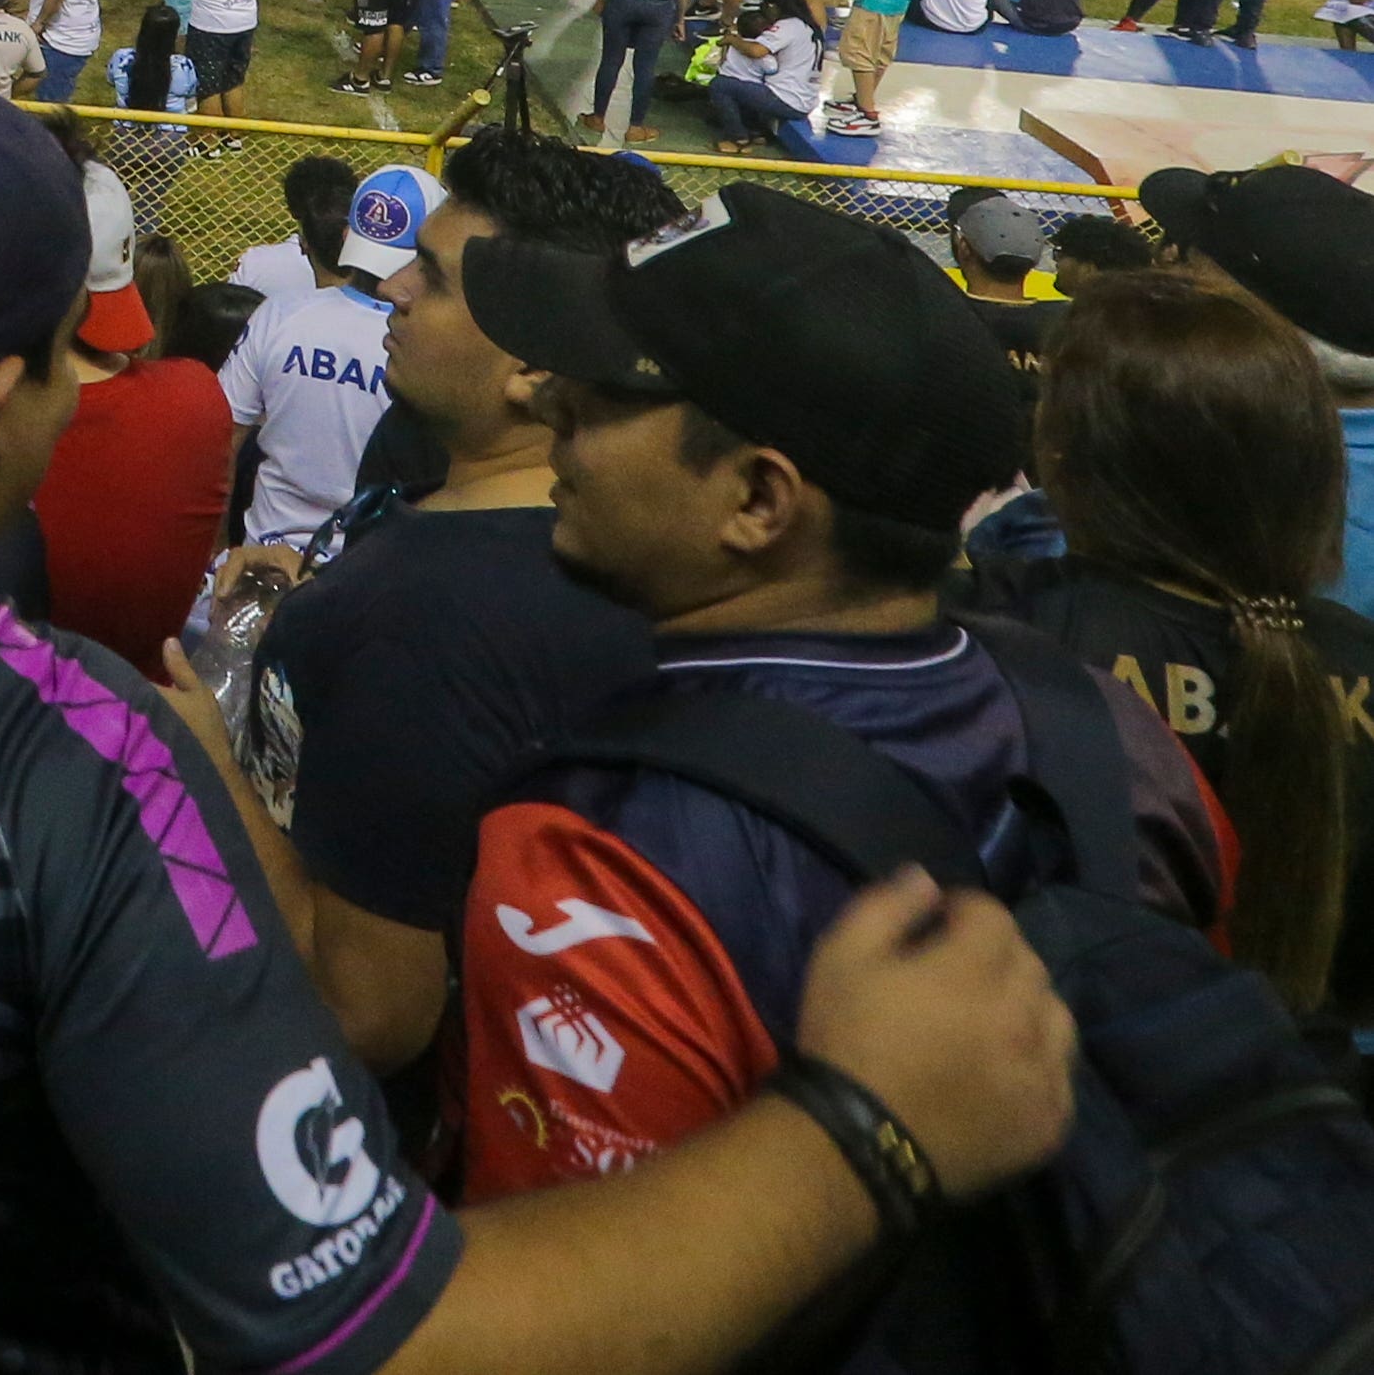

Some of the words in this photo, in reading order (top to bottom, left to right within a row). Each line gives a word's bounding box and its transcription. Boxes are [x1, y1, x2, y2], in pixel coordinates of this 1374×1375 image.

[365, 198, 392, 226] A
[282, 345, 385, 395] ABAN
[255, 1056, 380, 1227] G
